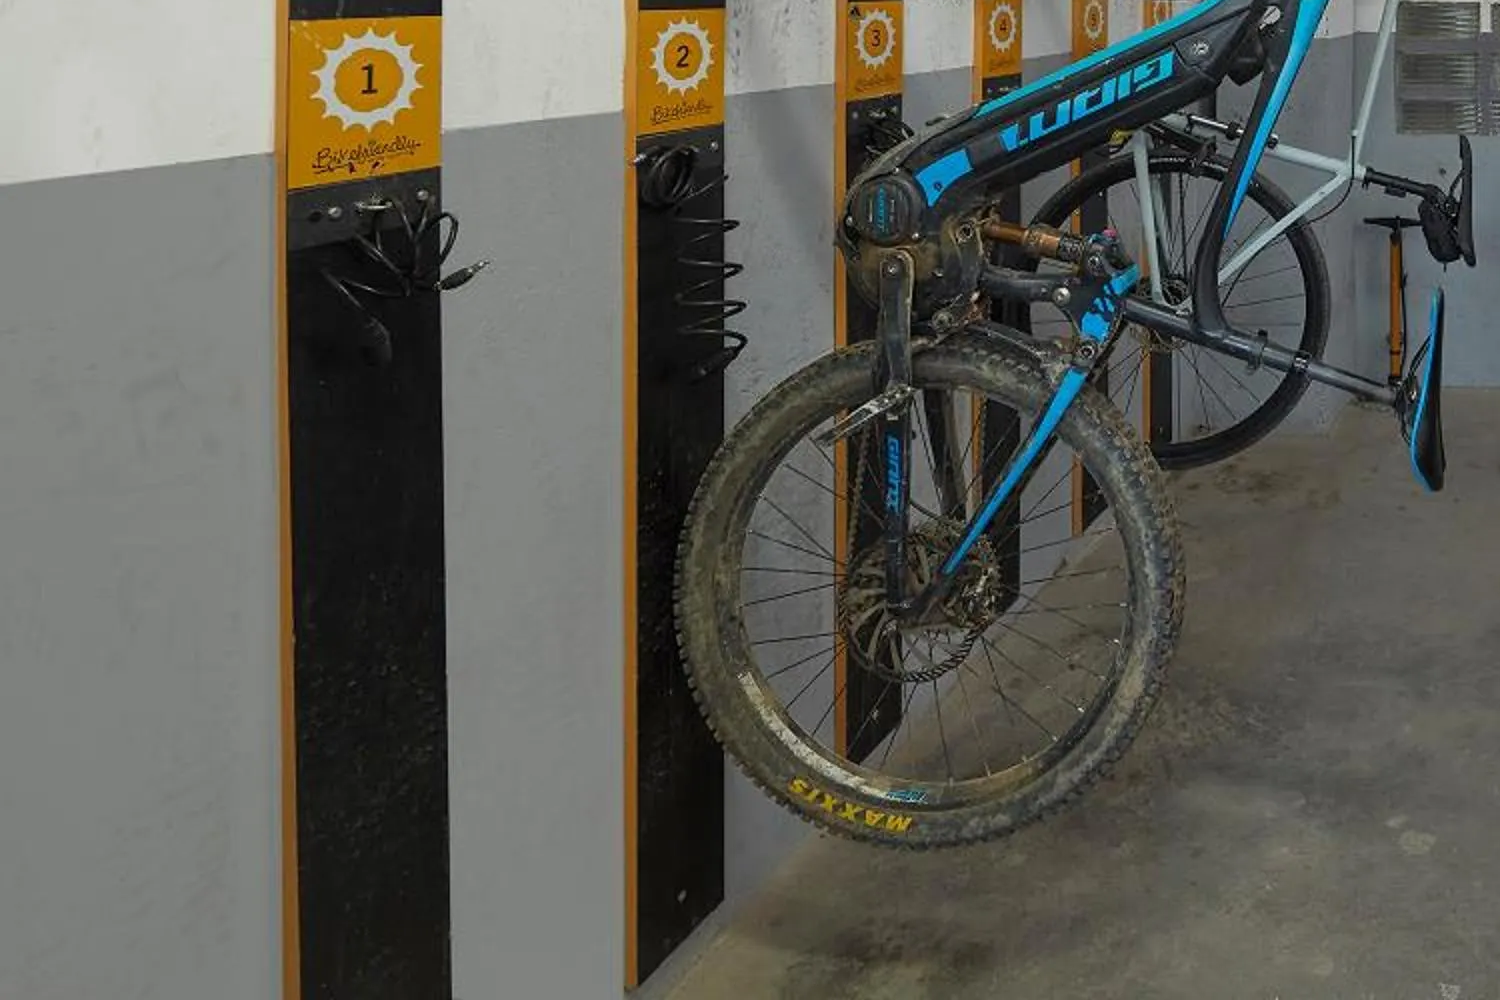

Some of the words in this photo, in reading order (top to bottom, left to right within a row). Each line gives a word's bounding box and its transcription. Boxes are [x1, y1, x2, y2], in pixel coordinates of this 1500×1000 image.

[871, 29, 881, 47] 3
[676, 45, 689, 68] 2
[361, 63, 379, 95] 1
